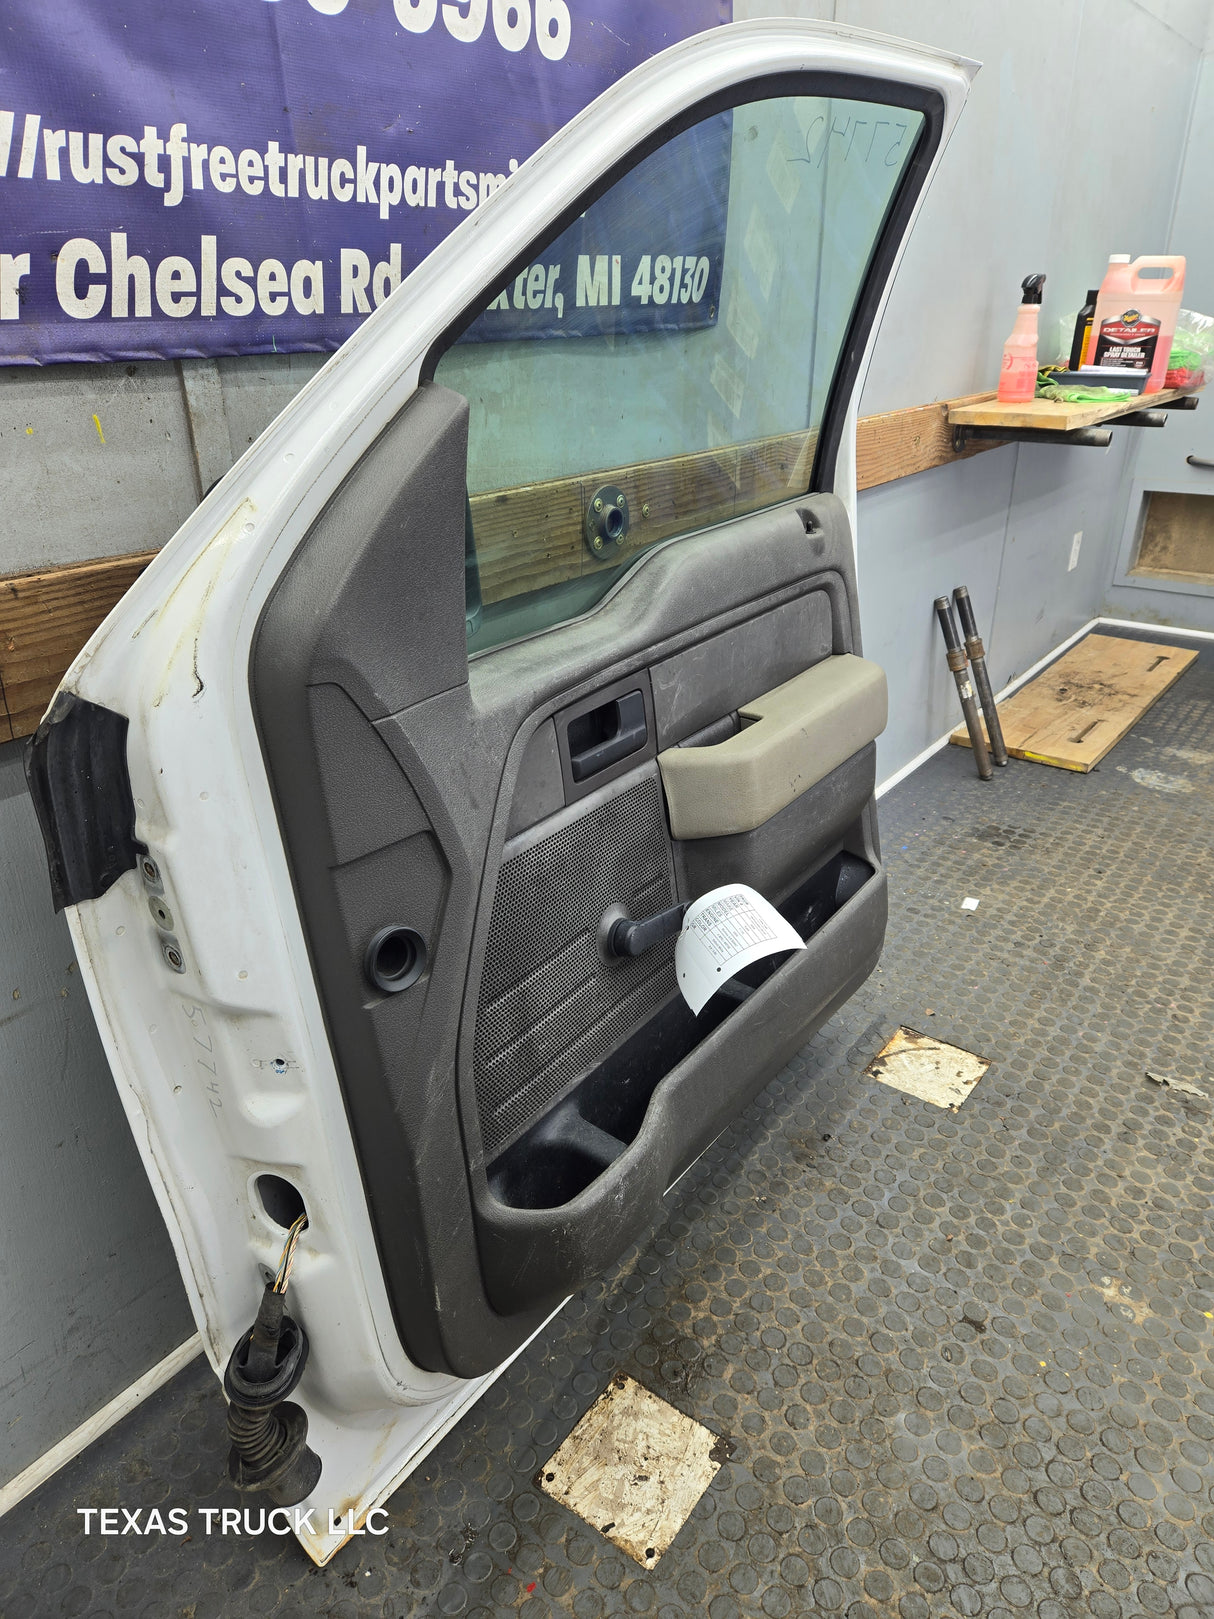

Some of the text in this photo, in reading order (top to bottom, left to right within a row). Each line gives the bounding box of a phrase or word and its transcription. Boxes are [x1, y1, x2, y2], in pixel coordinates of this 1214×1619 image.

[56, 232, 325, 320] Chelsea
[576, 254, 622, 307] MI
[631, 254, 710, 305] 48130
